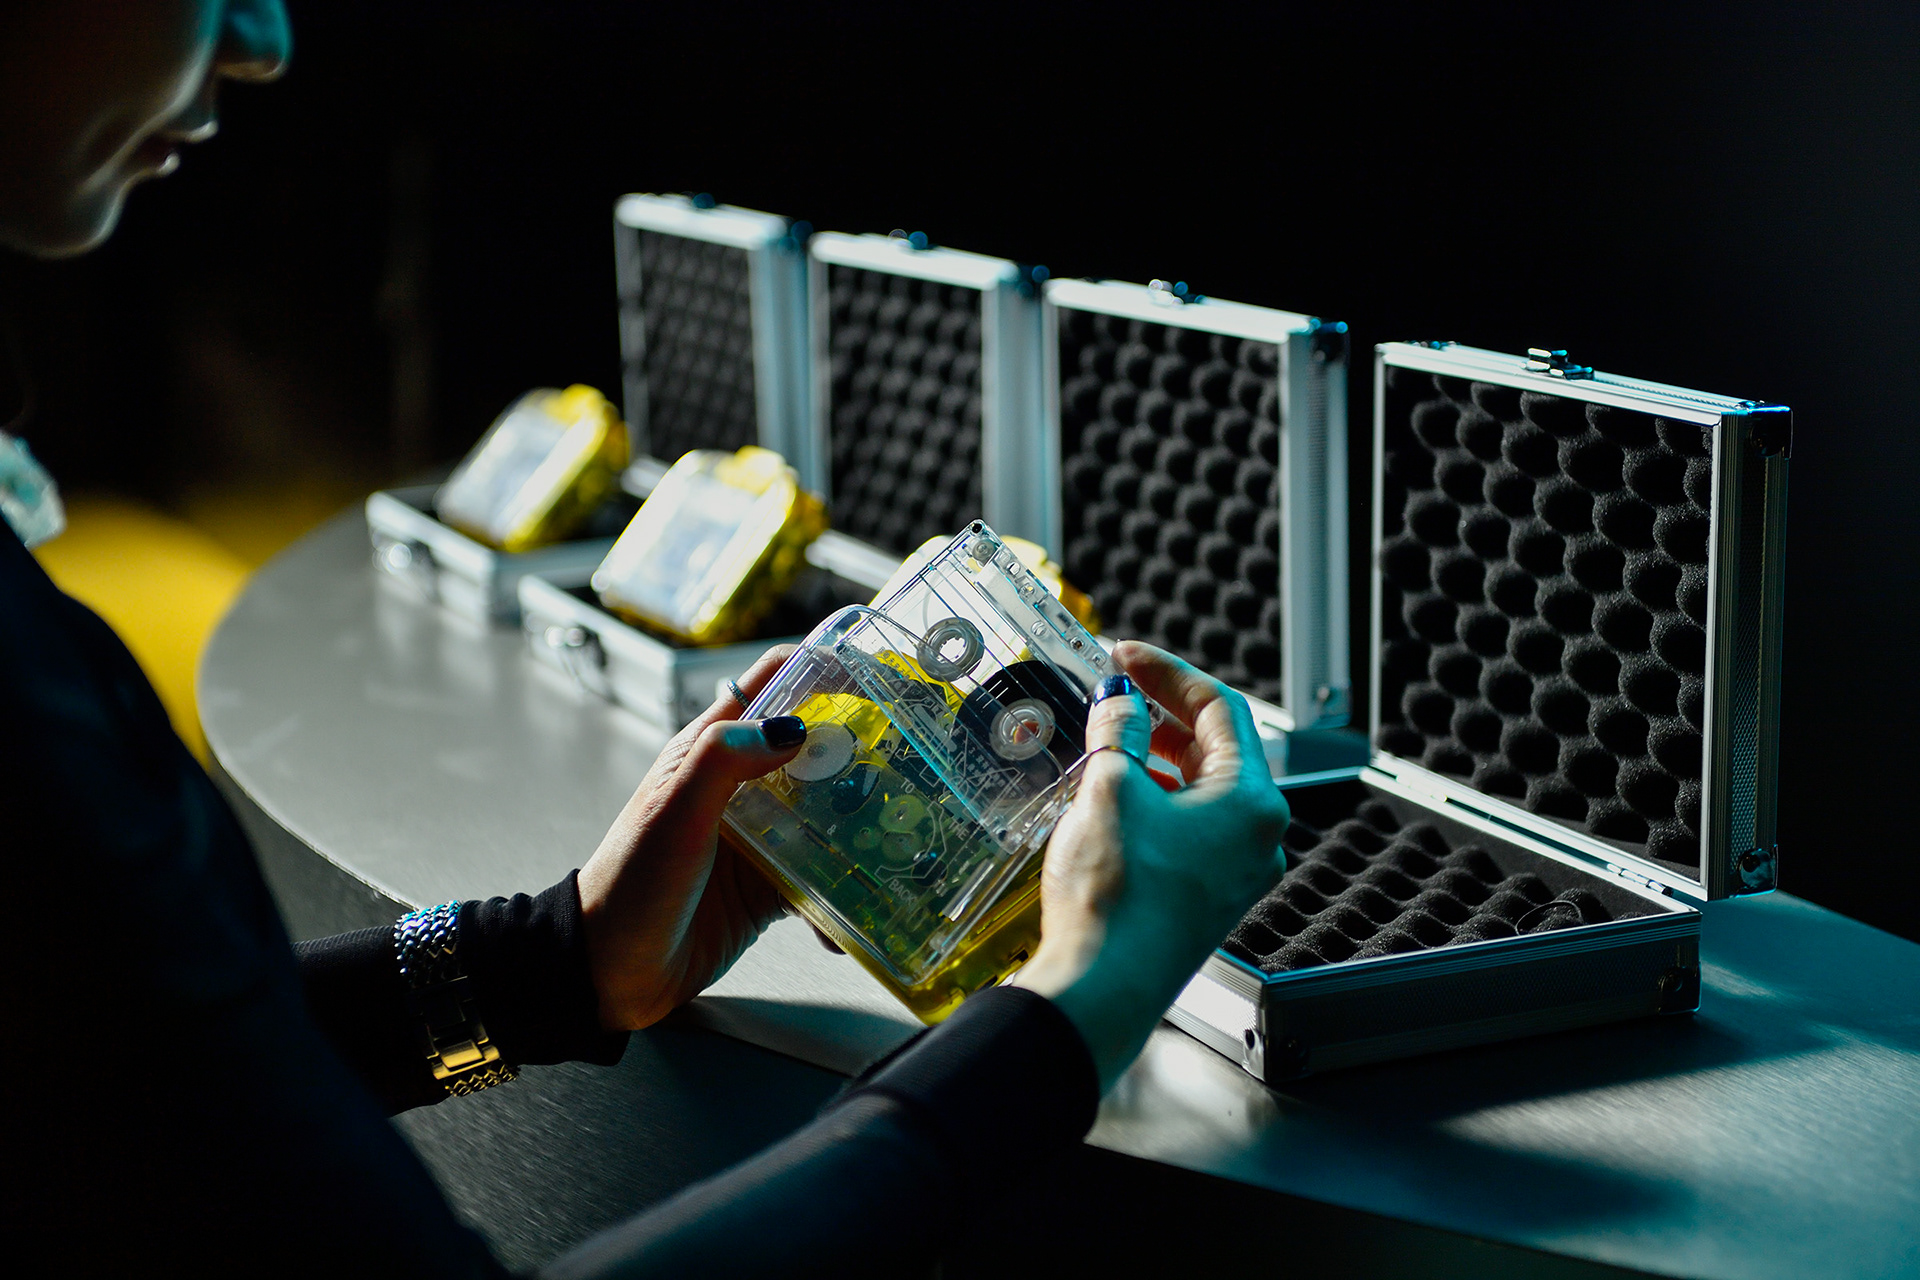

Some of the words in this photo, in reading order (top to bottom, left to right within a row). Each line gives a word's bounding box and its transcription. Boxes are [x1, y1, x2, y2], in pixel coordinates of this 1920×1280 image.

[897, 776, 916, 795] TO
[946, 817, 970, 841] THE
[825, 823, 839, 837] &
[887, 877, 917, 906] BACK
